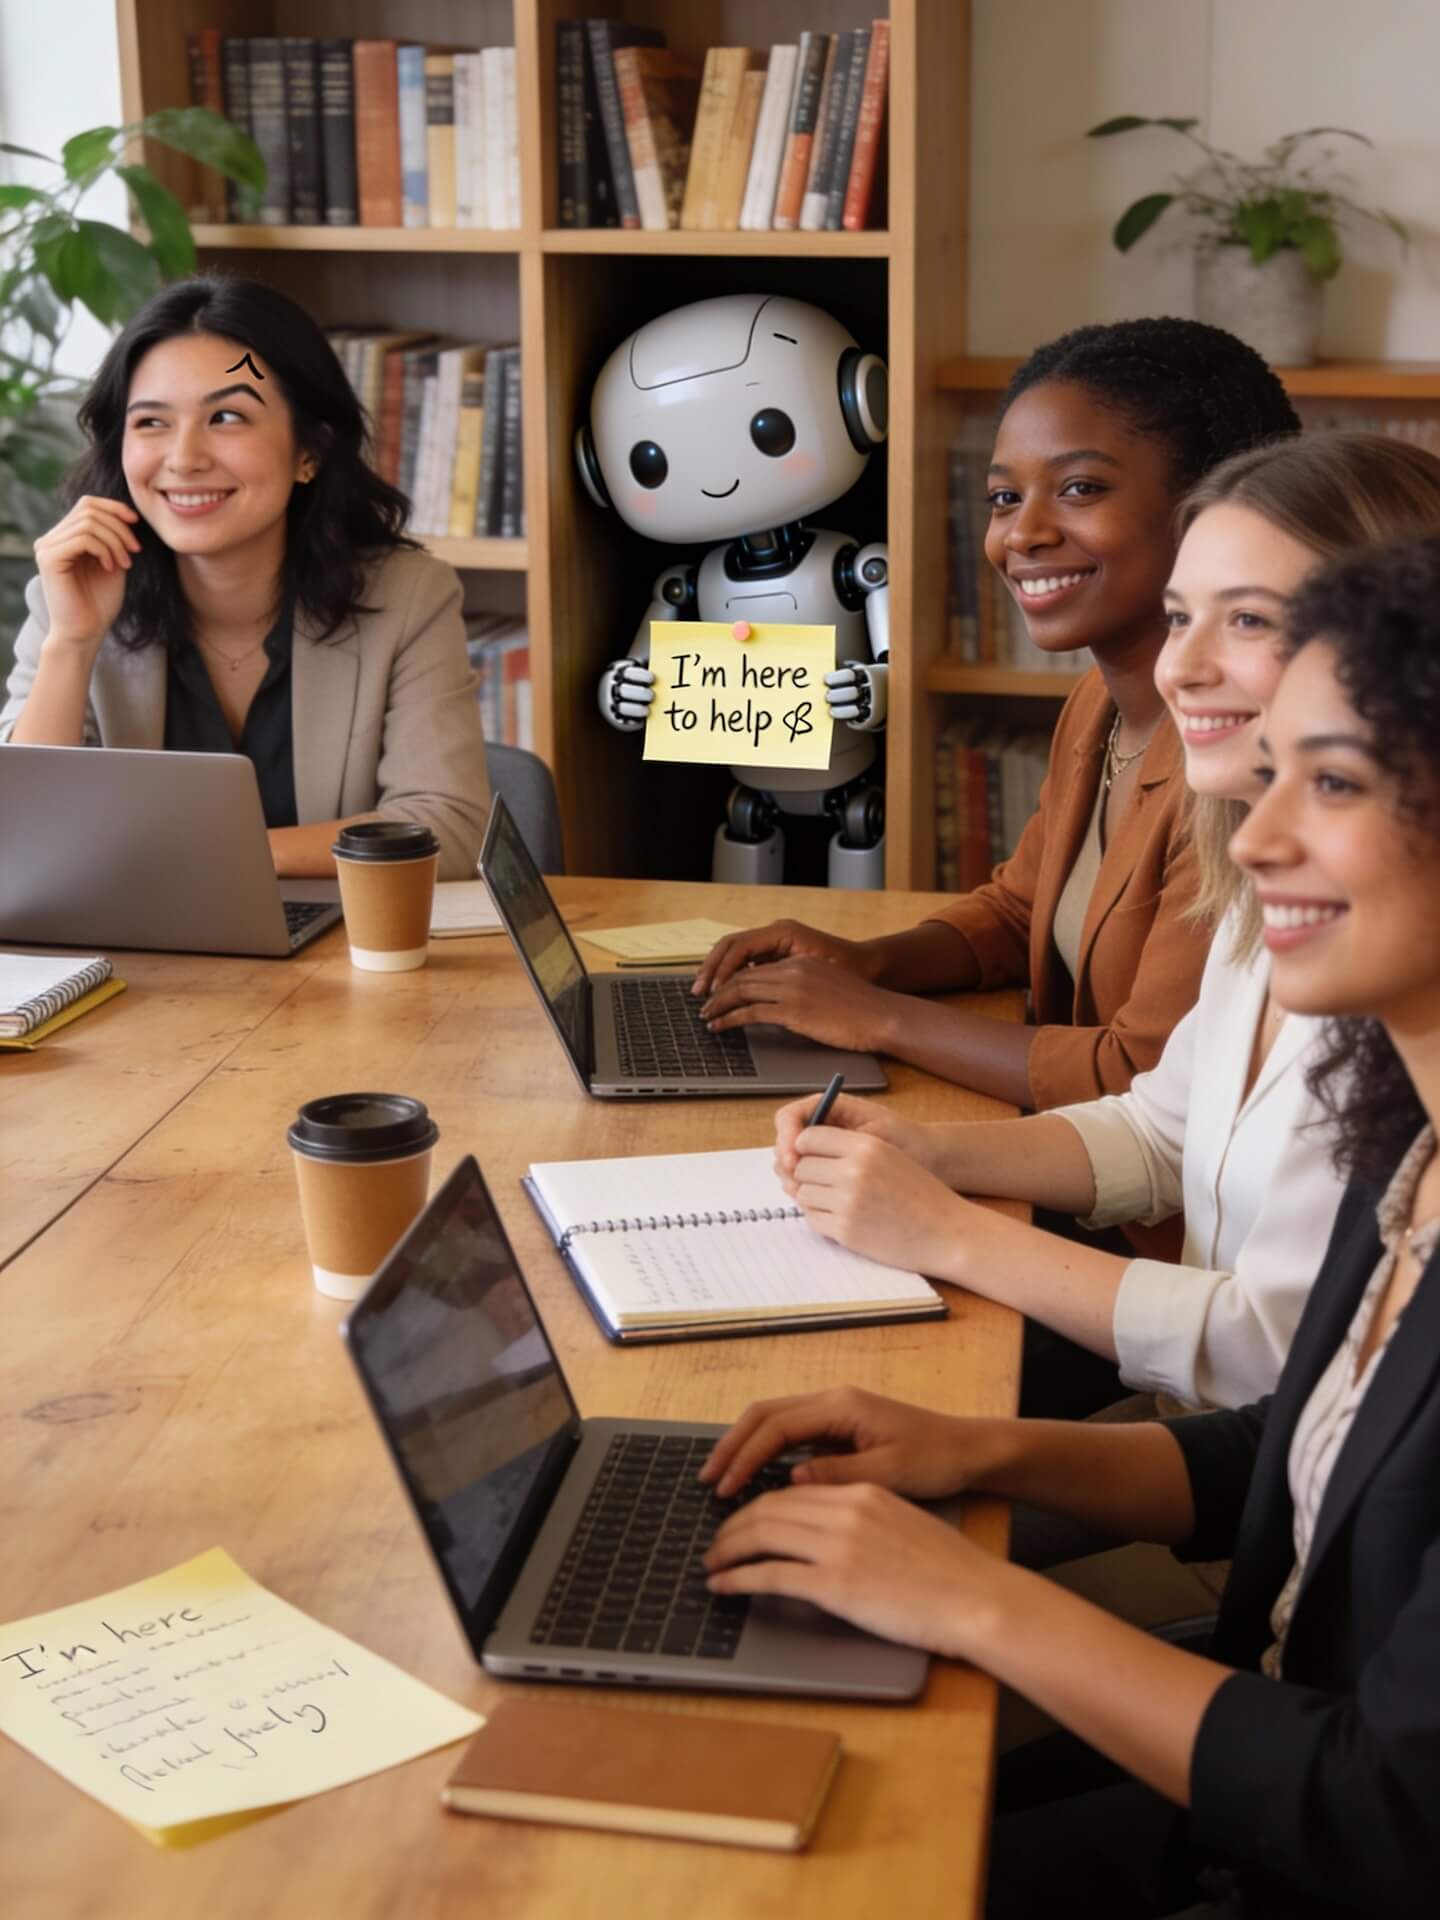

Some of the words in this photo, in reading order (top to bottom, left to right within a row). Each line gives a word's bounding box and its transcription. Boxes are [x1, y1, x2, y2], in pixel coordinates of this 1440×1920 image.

[671, 653, 727, 689] I'm
[741, 653, 811, 689] here
[663, 701, 698, 731] to
[709, 698, 773, 747] help
